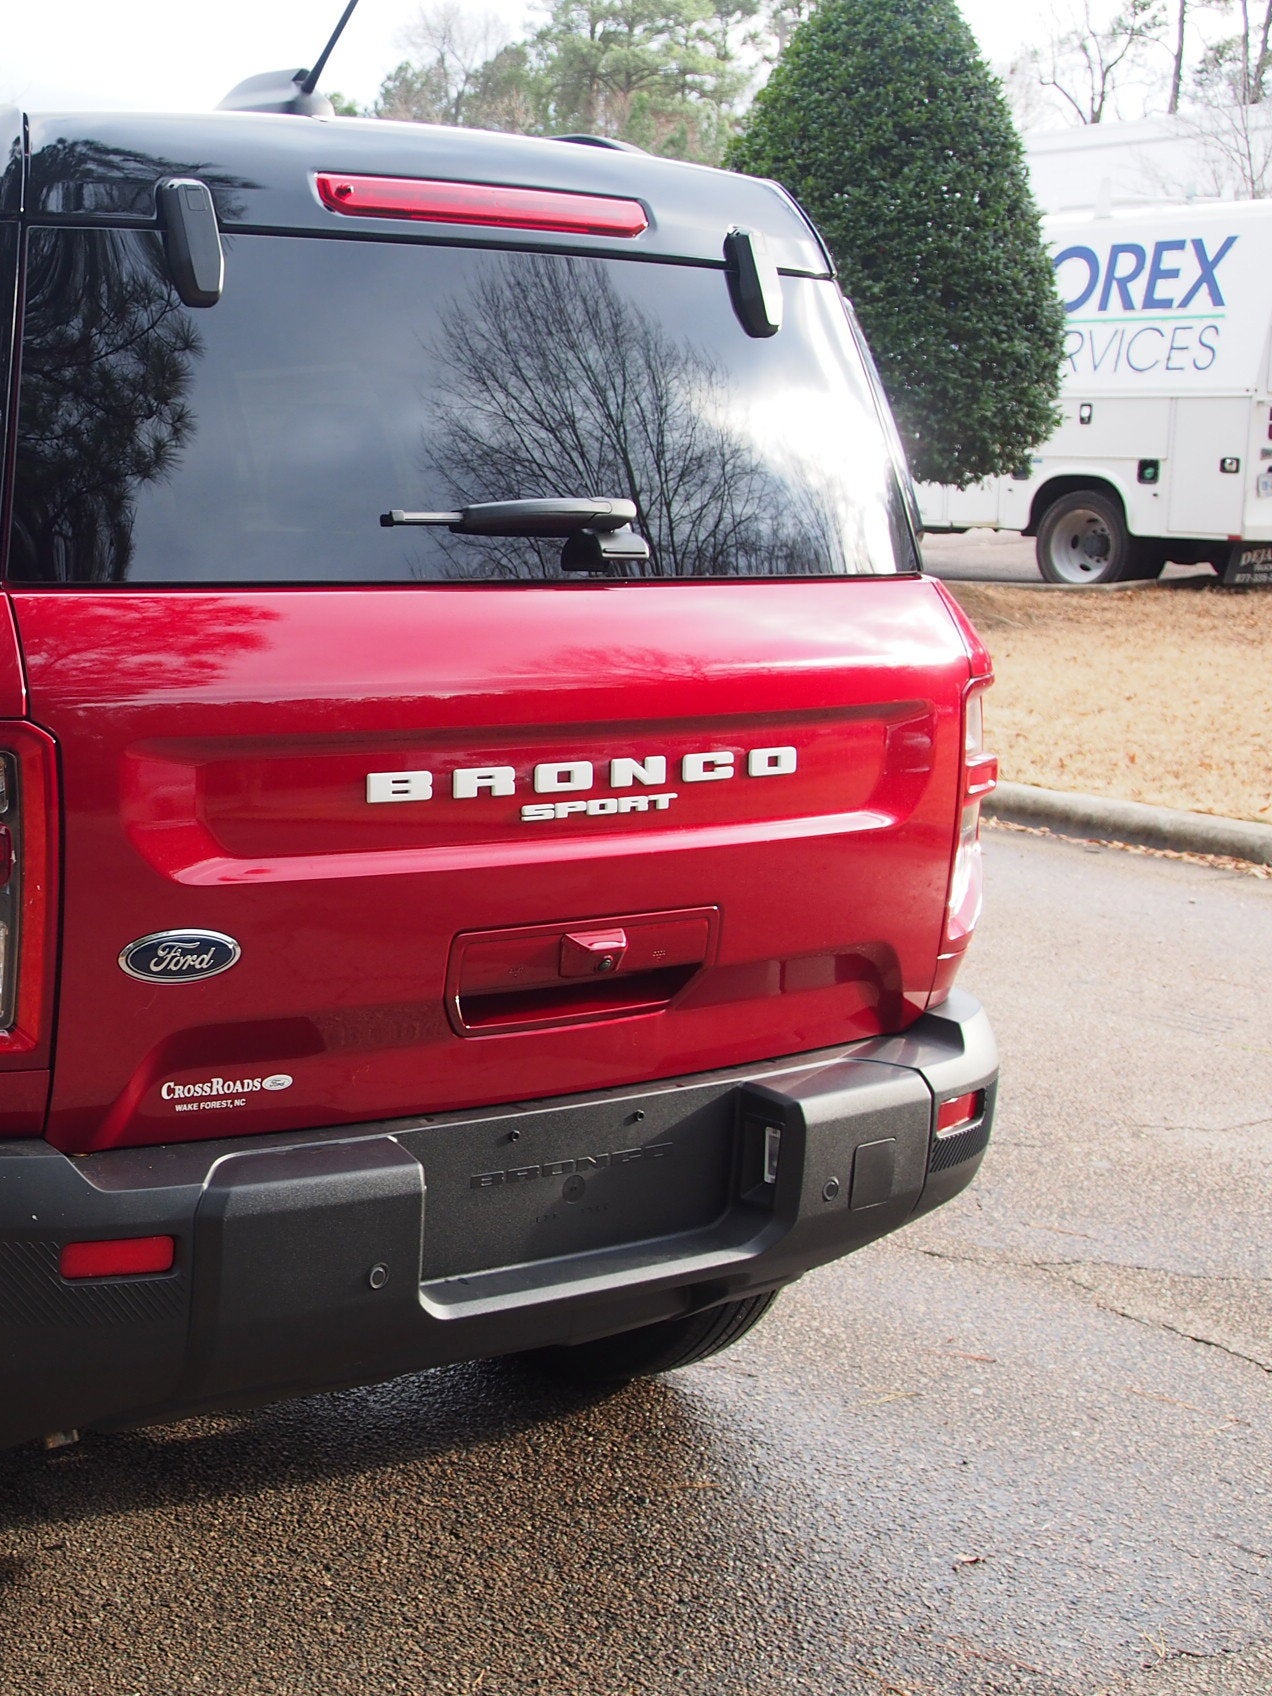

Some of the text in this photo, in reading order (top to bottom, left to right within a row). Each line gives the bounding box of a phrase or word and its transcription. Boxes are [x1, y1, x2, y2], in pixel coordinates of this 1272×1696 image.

[366, 745, 798, 804] BRONCO
[521, 793, 678, 822] SPORT
[149, 941, 216, 972] Ford
[175, 1098, 246, 1112] WAKE FOREST, NC
